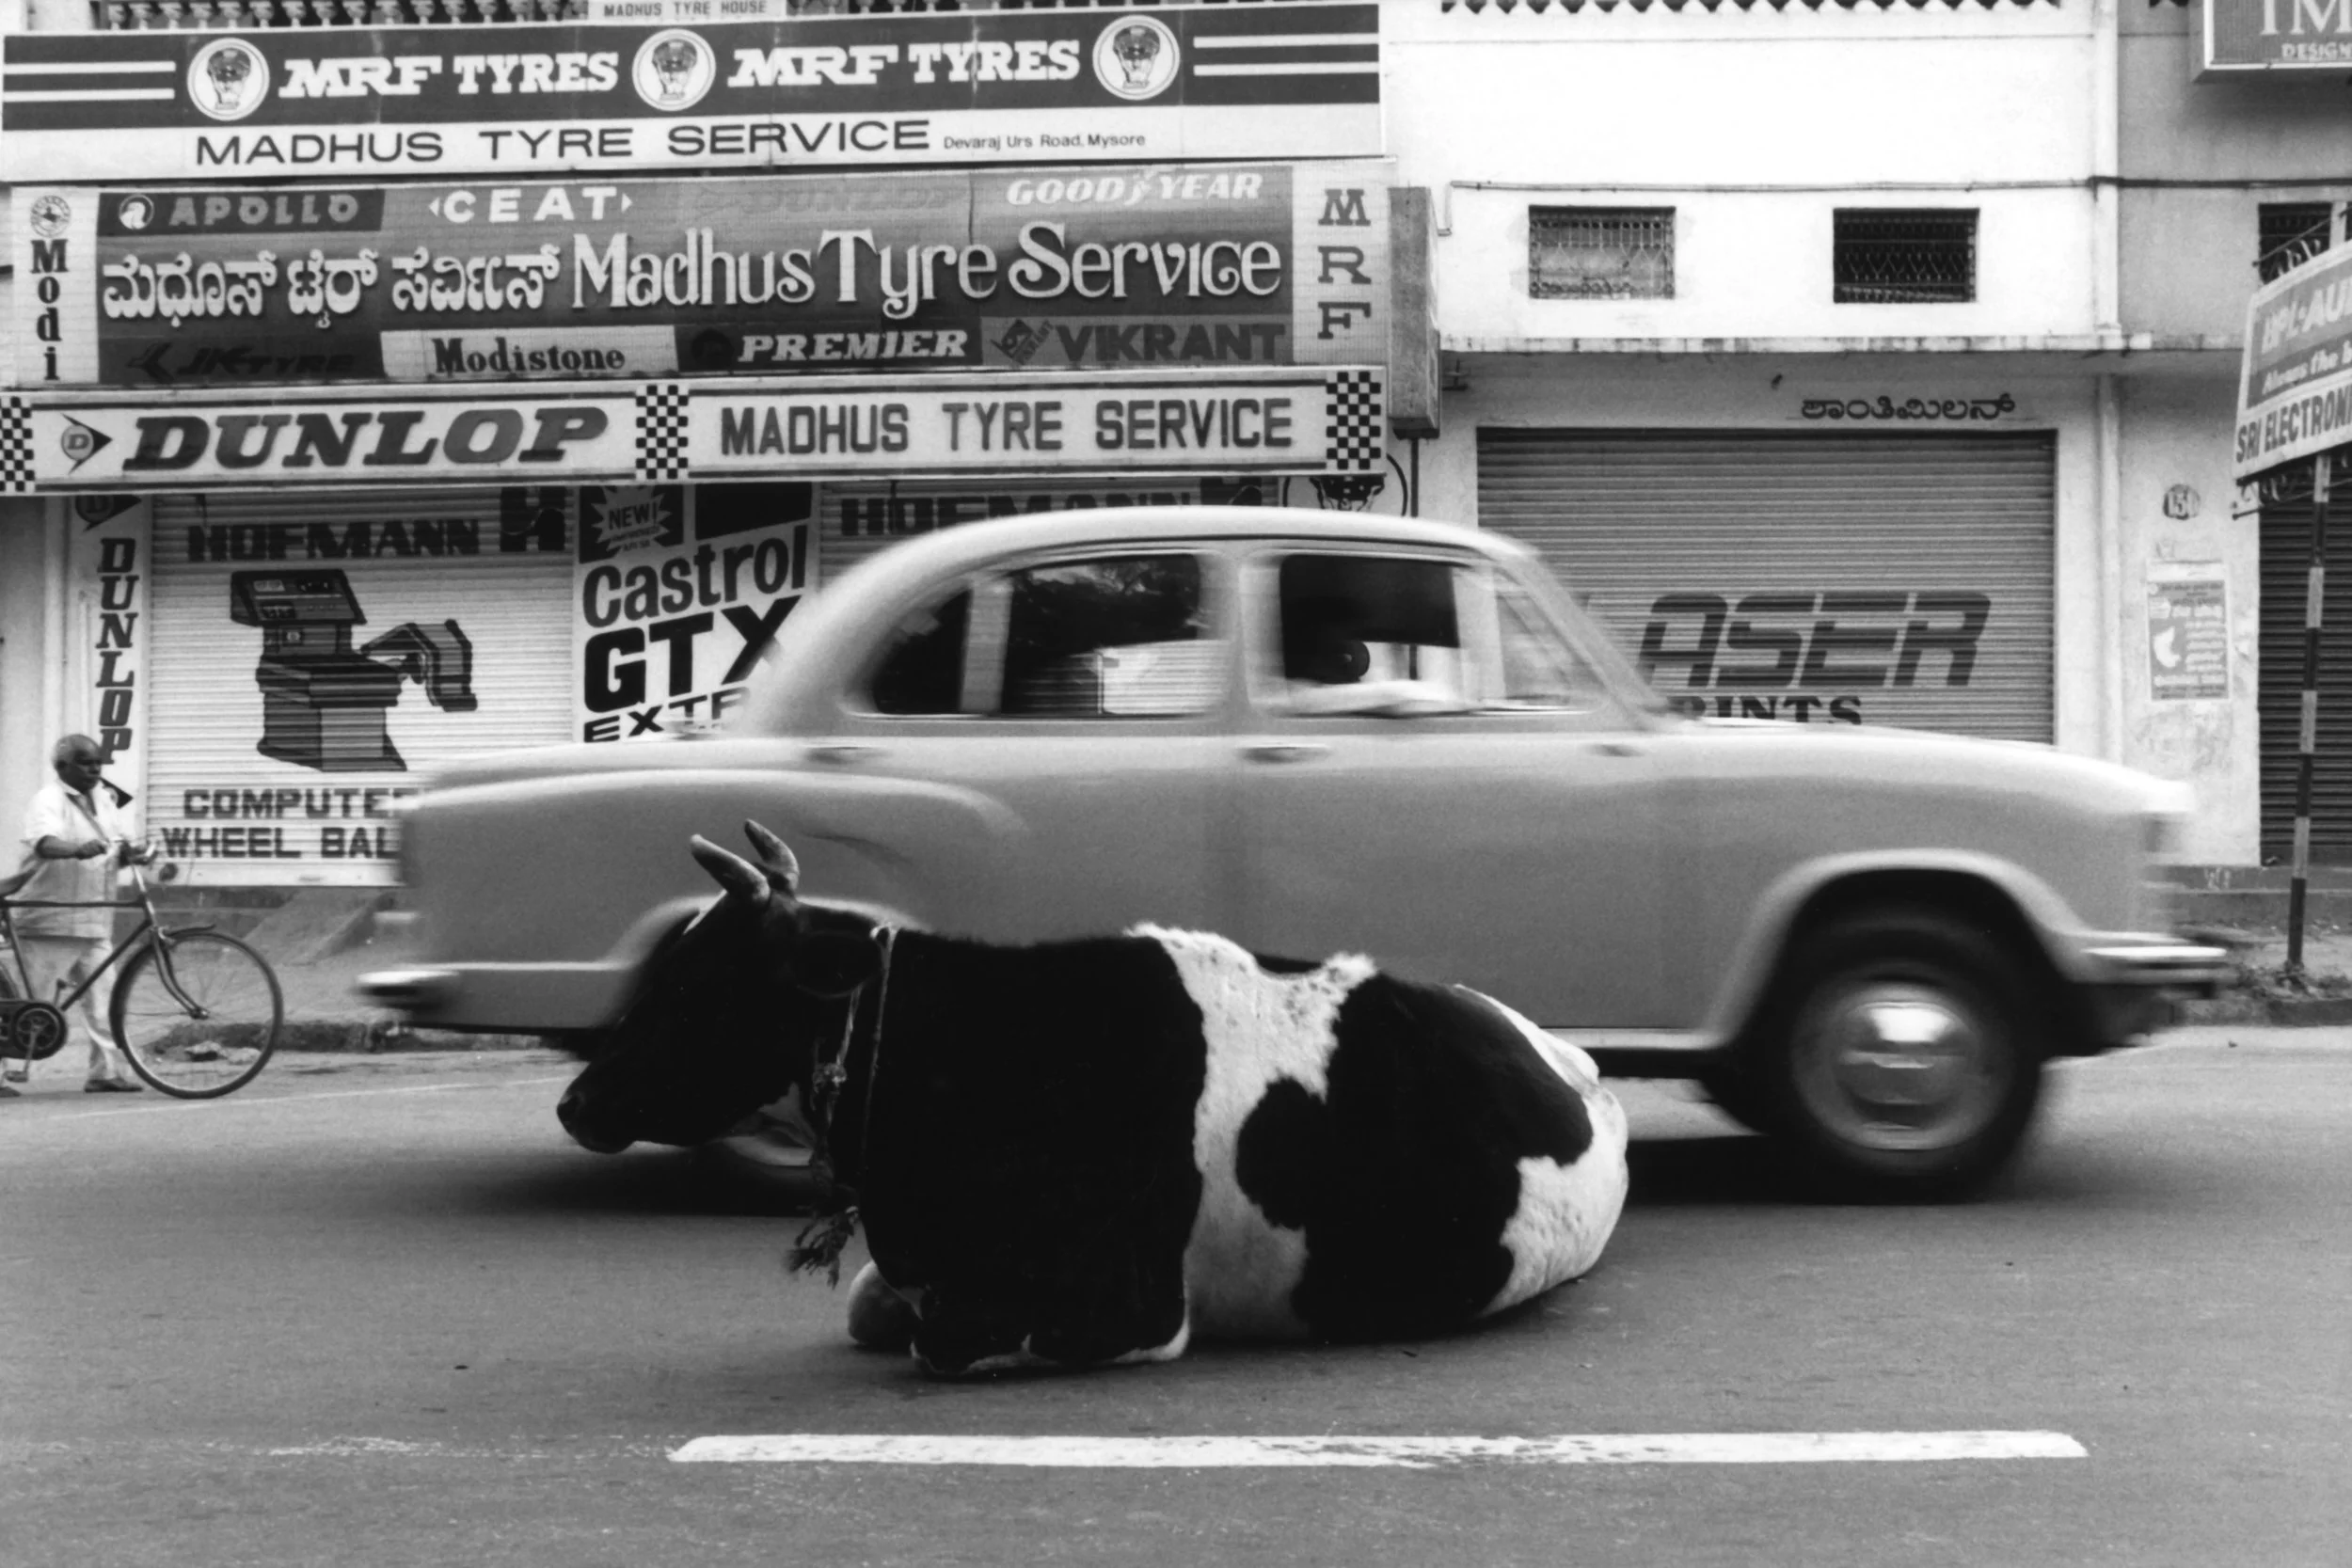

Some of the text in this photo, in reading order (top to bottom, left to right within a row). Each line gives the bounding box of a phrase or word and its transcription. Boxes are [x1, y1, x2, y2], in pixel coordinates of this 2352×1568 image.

[603, 1, 767, 17] MADHUS TYRE HOUSE
[278, 52, 619, 98] MRF TYRES
[727, 40, 1080, 87] MRF TYRES
[197, 132, 444, 166] MADHUS
[479, 128, 633, 160] TYRE
[668, 119, 930, 156] SERVICE
[944, 135, 1001, 151] Devaraj
[1007, 135, 1033, 149] Urs
[1087, 133, 1146, 149] Mysore
[168, 195, 359, 227] APOLLO
[444, 187, 617, 223] CEAT
[571, 220, 1281, 319] Madhus Tyre Service
[1318, 188, 1372, 340] MRF
[30, 238, 70, 381] Modi
[431, 337, 626, 374] Modistone
[738, 329, 968, 362] PREMIER
[1055, 324, 1287, 363] VIKRANT
[121, 406, 609, 471] DUNLOP
[722, 398, 1293, 455] MADHUS TYRE SERVICE
[187, 518, 481, 562] HOFMANN
[582, 524, 808, 628] Castrol
[95, 537, 140, 765] DUNLOP
[583, 594, 803, 713] GTX
[1583, 592, 1991, 688] ASER
[183, 787, 420, 819] COMPUTE
[161, 827, 301, 858] WHEEL
